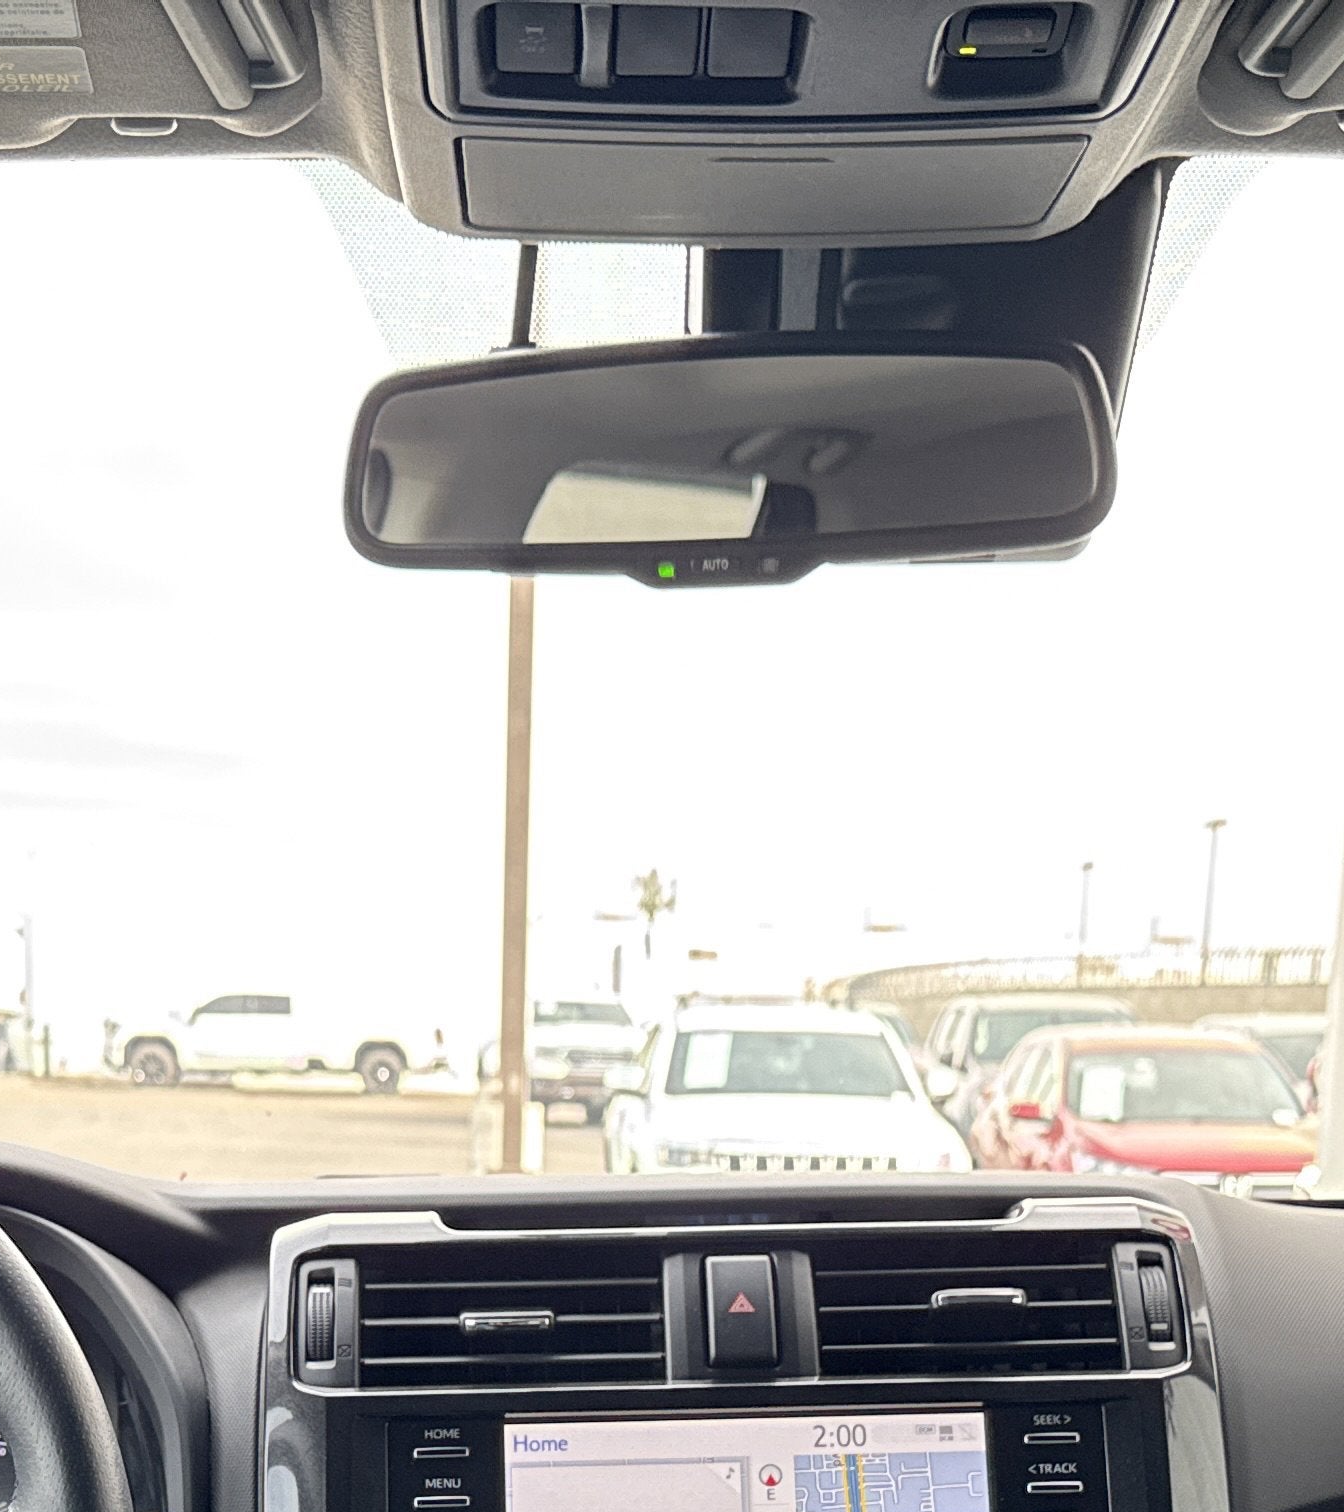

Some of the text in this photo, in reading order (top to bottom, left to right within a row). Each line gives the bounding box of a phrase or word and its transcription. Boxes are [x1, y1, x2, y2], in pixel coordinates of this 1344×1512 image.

[701, 558, 729, 571] AUTO
[1032, 1414, 1063, 1425] SEEK
[424, 1428, 461, 1440] HOME
[812, 1423, 867, 1448] 2:00
[512, 1434, 569, 1452] Home
[1037, 1462, 1078, 1474] TRACK
[424, 1478, 461, 1489] MENU
[767, 1488, 776, 1501] E
